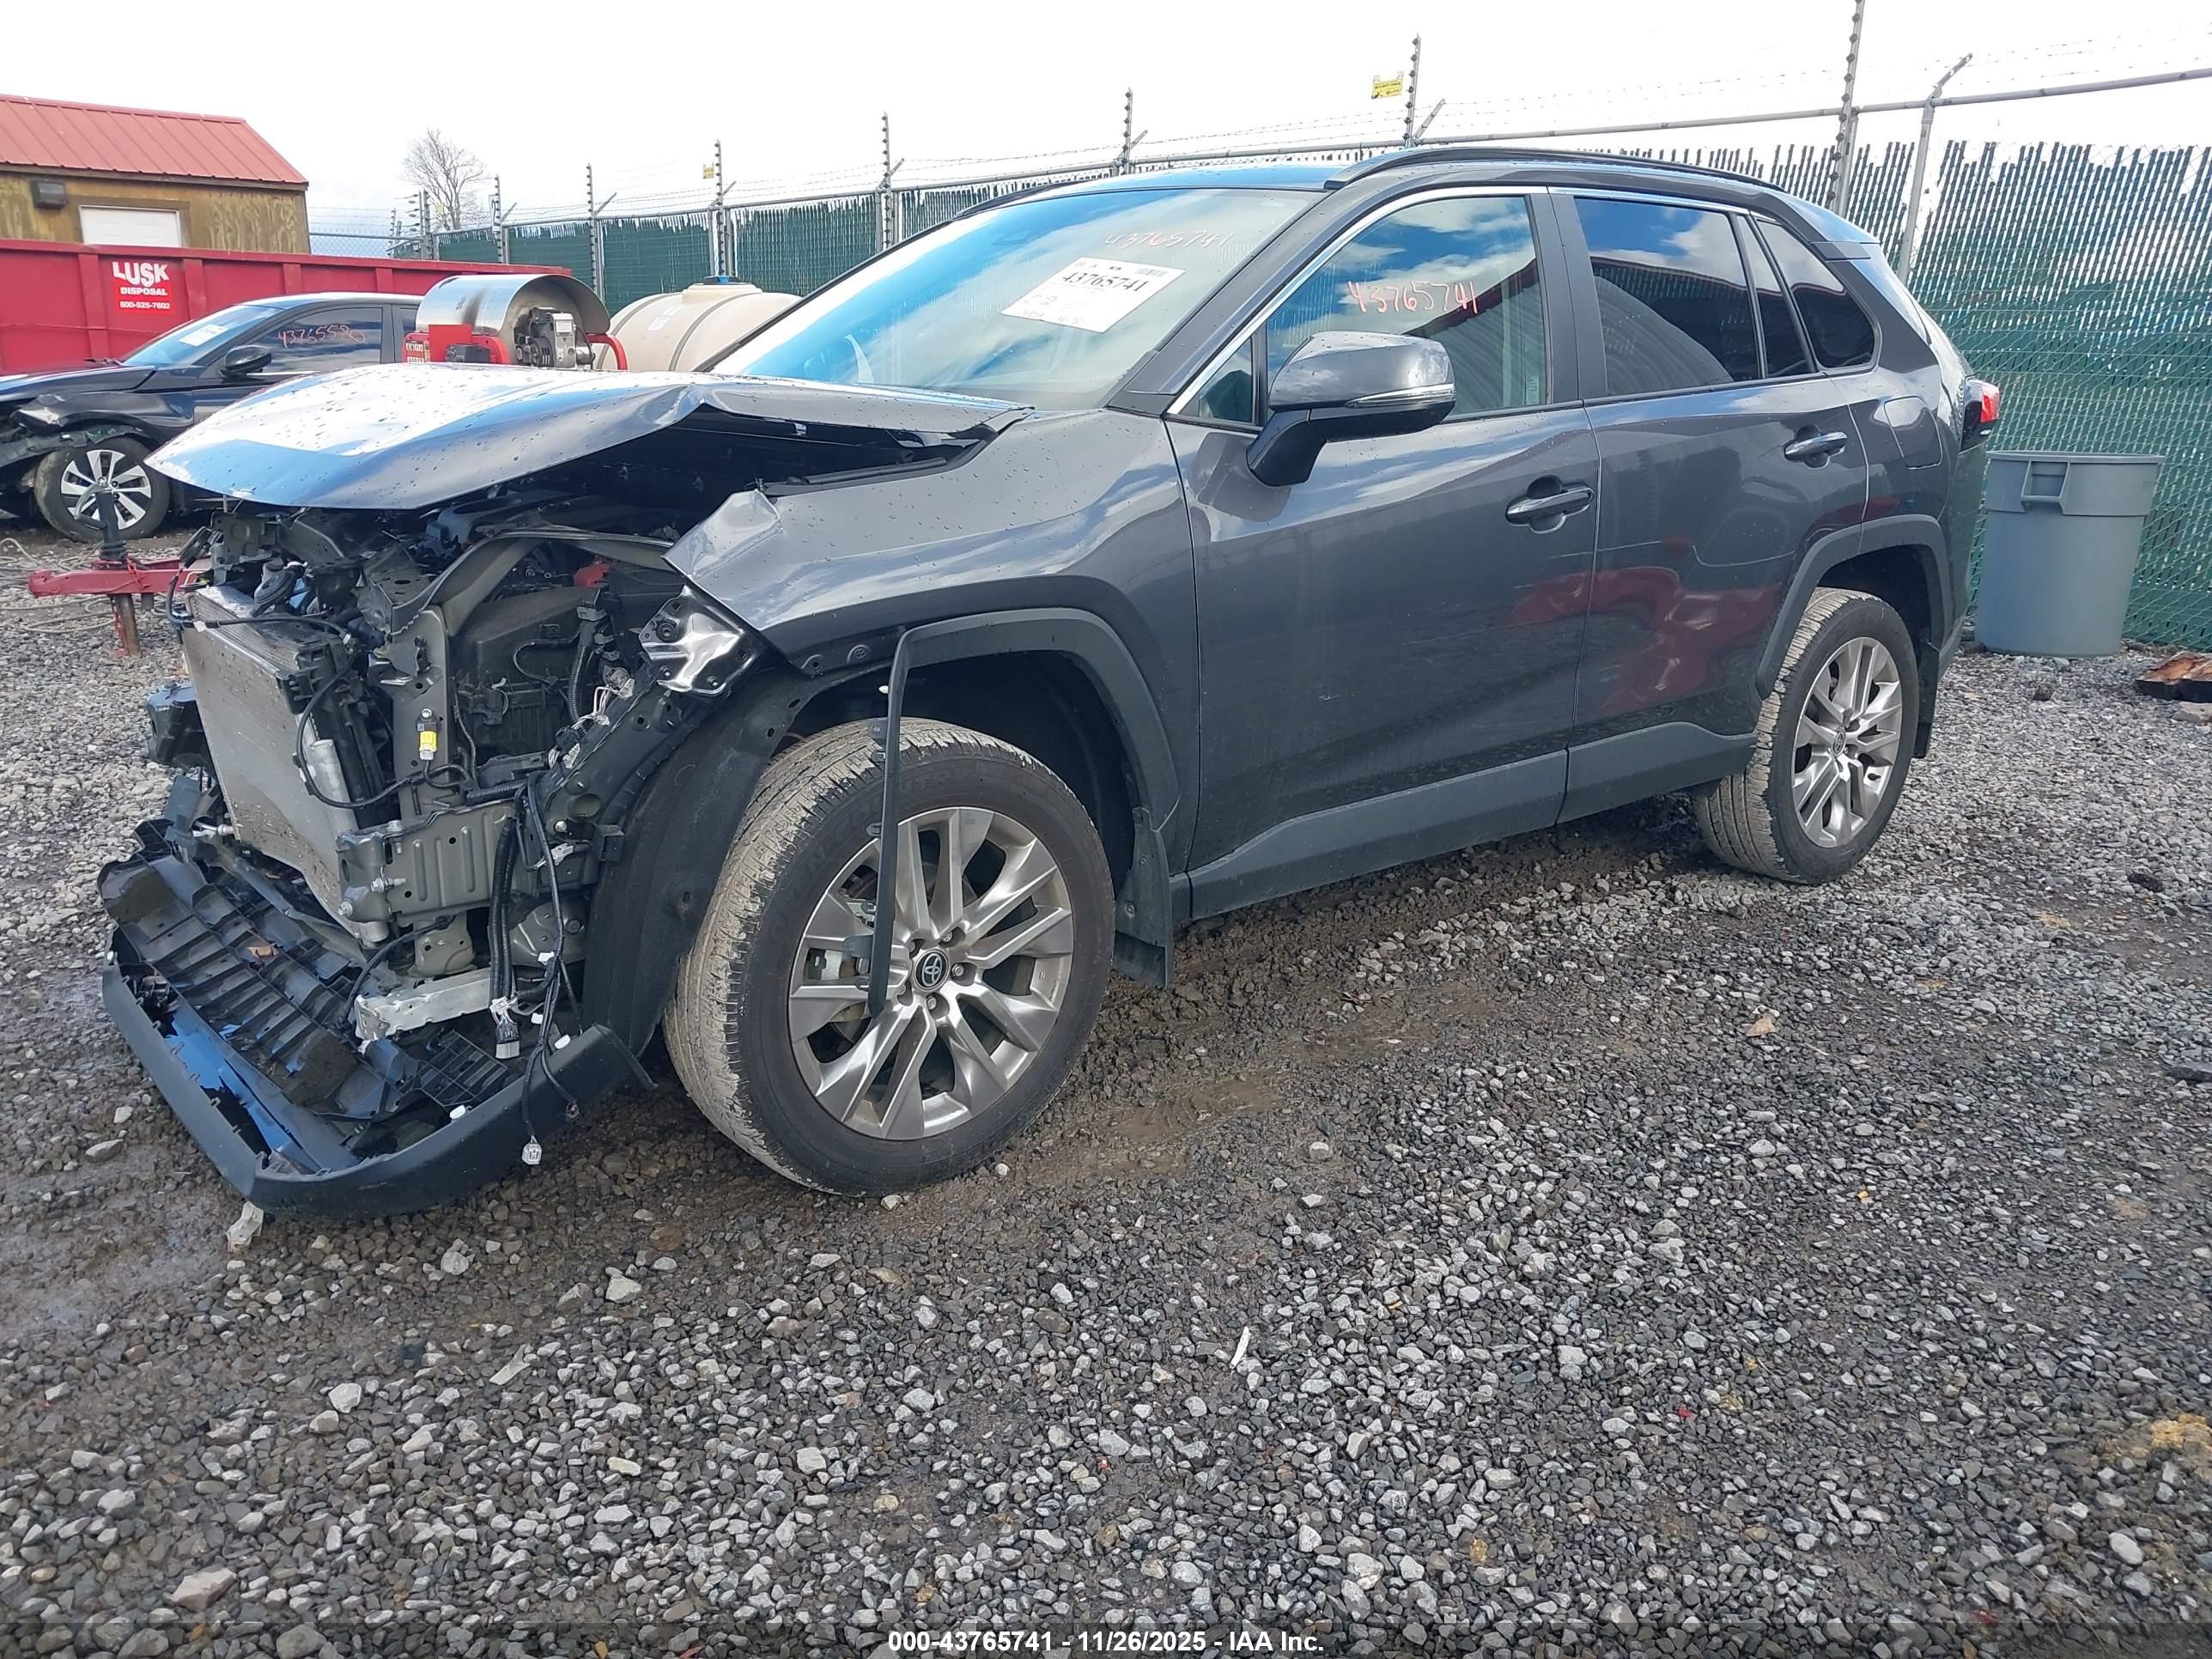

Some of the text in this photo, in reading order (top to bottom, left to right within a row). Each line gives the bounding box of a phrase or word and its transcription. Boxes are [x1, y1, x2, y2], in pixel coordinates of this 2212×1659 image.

[1105, 230, 1235, 249] 43765741
[112, 261, 170, 288] LUSK
[1061, 271, 1149, 292] 43765741
[119, 286, 168, 296] DISPOSAL
[1347, 280, 1478, 314] 43765741
[277, 325, 366, 349] 43765580
